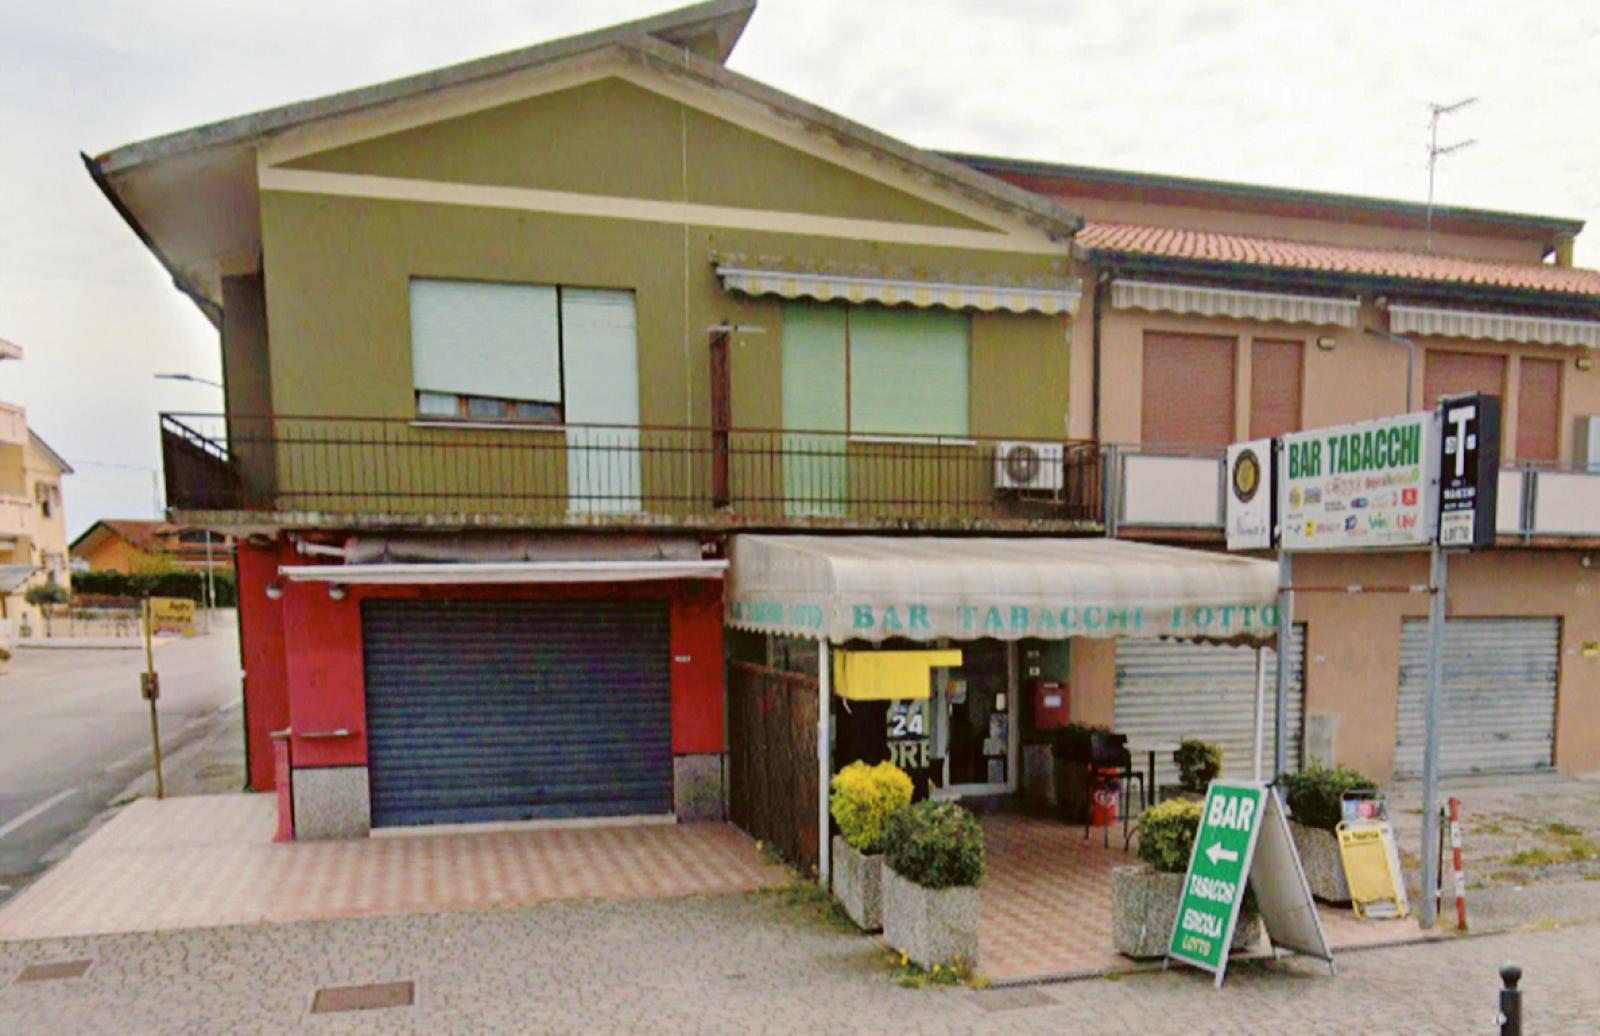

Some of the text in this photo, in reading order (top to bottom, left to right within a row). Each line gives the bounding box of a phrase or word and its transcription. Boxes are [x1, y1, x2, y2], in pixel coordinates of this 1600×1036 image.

[1289, 441, 1322, 480] BAR
[1328, 423, 1422, 474] TABACCHI
[853, 603, 1281, 630] BAR TABACCHI LOTTO
[892, 714, 924, 736] 24
[1208, 796, 1255, 832] BAR
